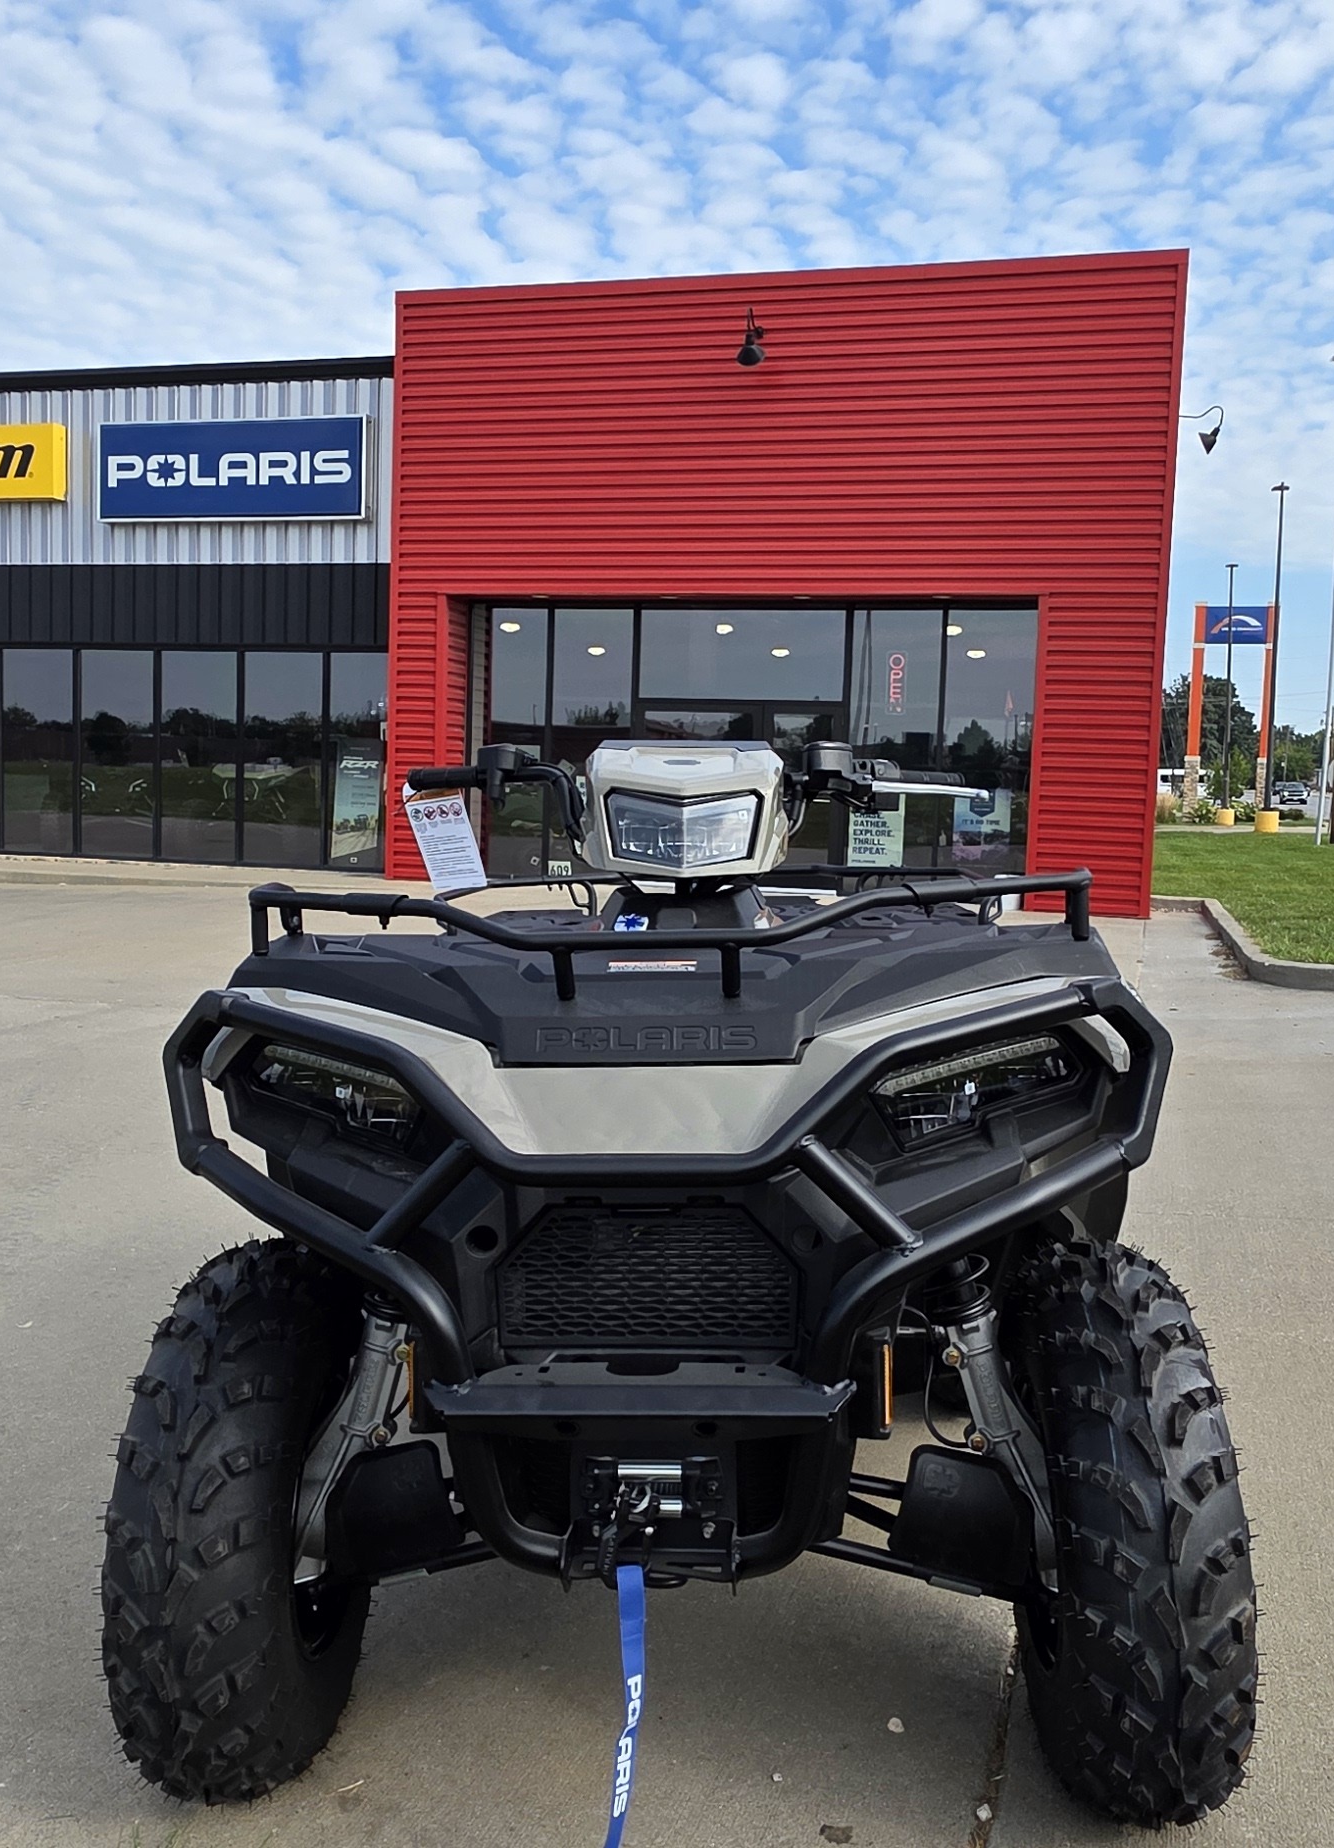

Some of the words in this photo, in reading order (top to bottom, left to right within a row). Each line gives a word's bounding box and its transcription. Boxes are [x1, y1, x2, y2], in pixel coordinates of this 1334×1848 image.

[107, 449, 352, 488] POLARIS
[339, 760, 380, 769] RZR
[853, 820, 890, 828] GATHER.
[853, 829, 895, 837] EXPLORE.
[853, 838, 886, 846] THRILL.
[852, 846, 888, 855] REPEAT.
[551, 865, 569, 876] 609
[536, 1025, 758, 1052] POLARIS
[613, 1674, 642, 1818] POLARIS
